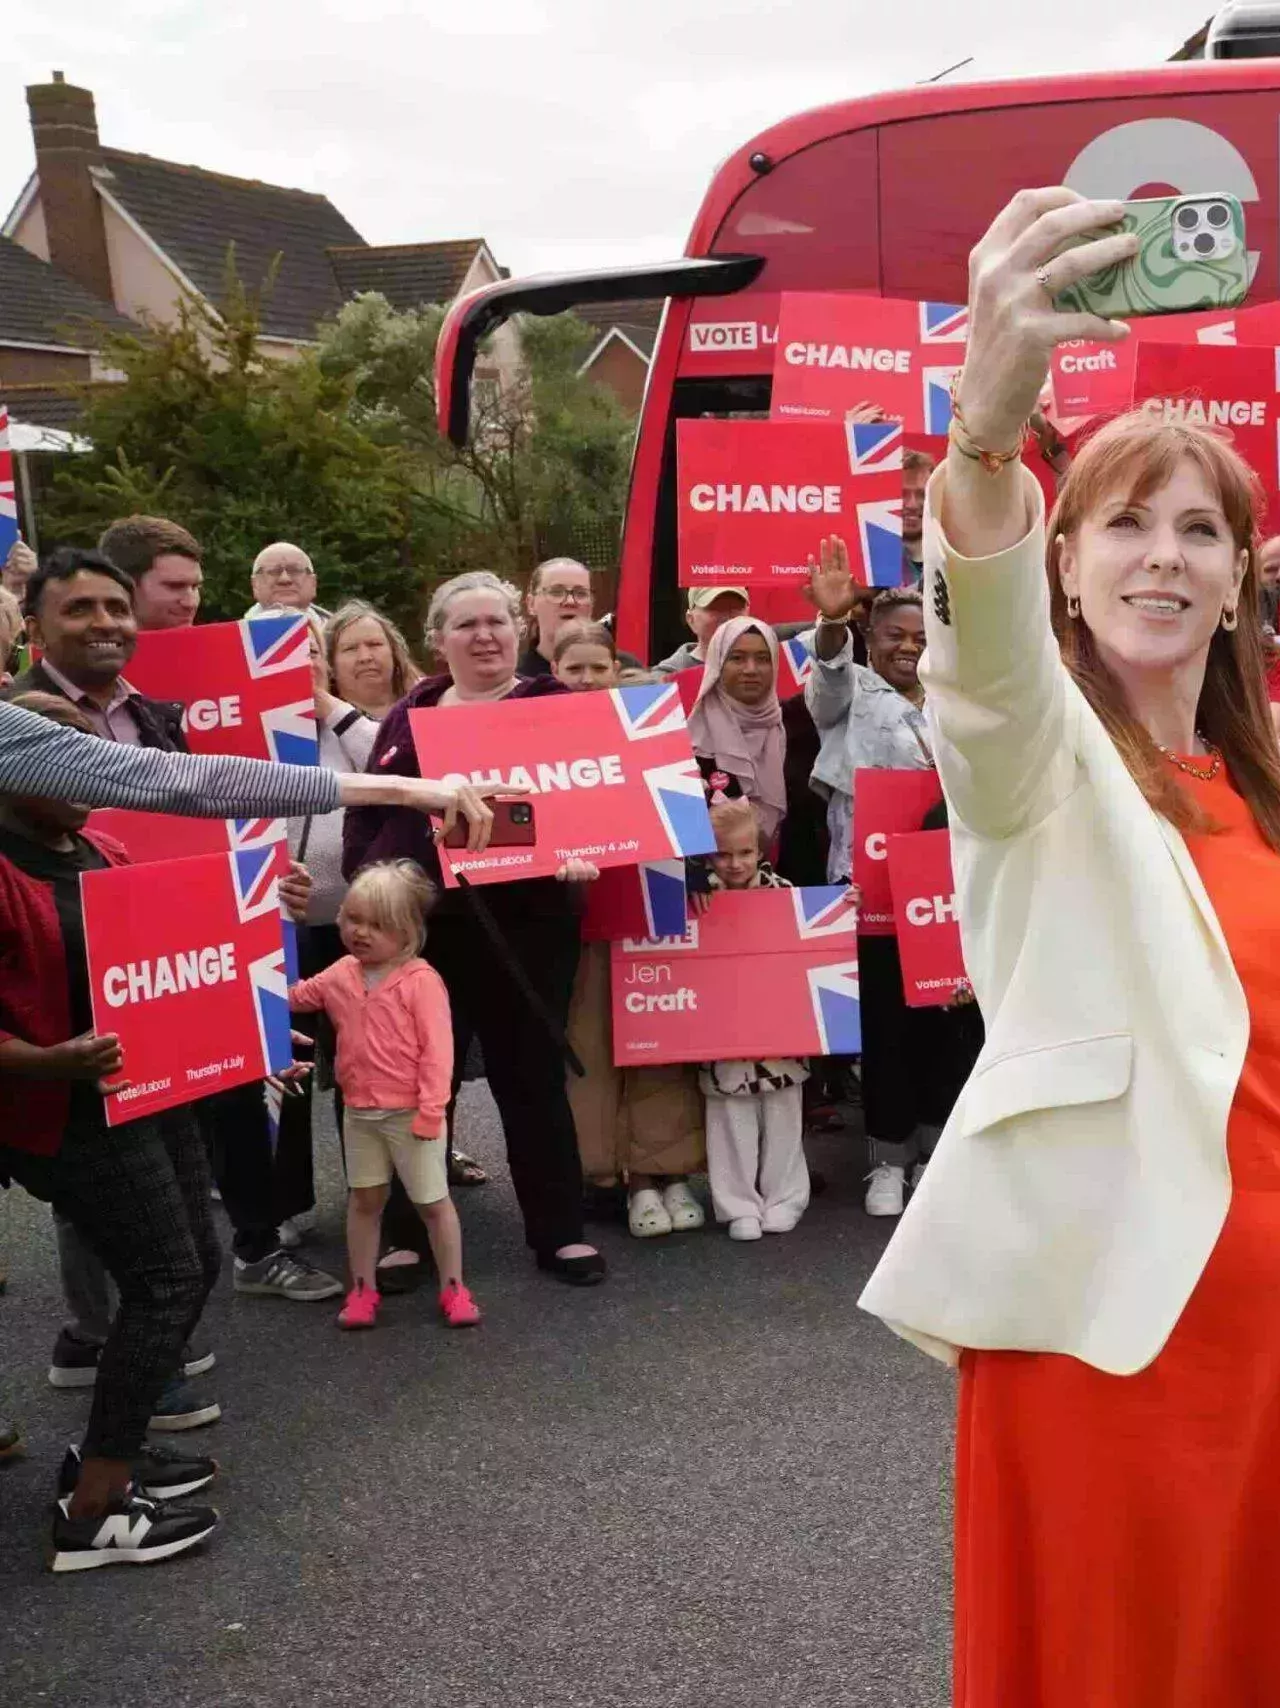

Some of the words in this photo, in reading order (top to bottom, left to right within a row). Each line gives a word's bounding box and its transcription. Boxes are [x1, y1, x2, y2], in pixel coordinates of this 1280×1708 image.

[695, 326, 752, 345] VOTE
[784, 342, 912, 374] CHANGE
[1060, 349, 1117, 373] Craft
[1142, 398, 1267, 426] CHANGE
[690, 483, 842, 513] CHANGE
[771, 565, 811, 575] Thursda
[554, 845, 607, 861] Thursday
[618, 839, 639, 852] July
[103, 942, 237, 1008] CHANGE
[624, 963, 671, 984] Jen
[625, 986, 698, 1014] Craft
[186, 1062, 222, 1082] Thursday
[229, 1055, 245, 1070] July
